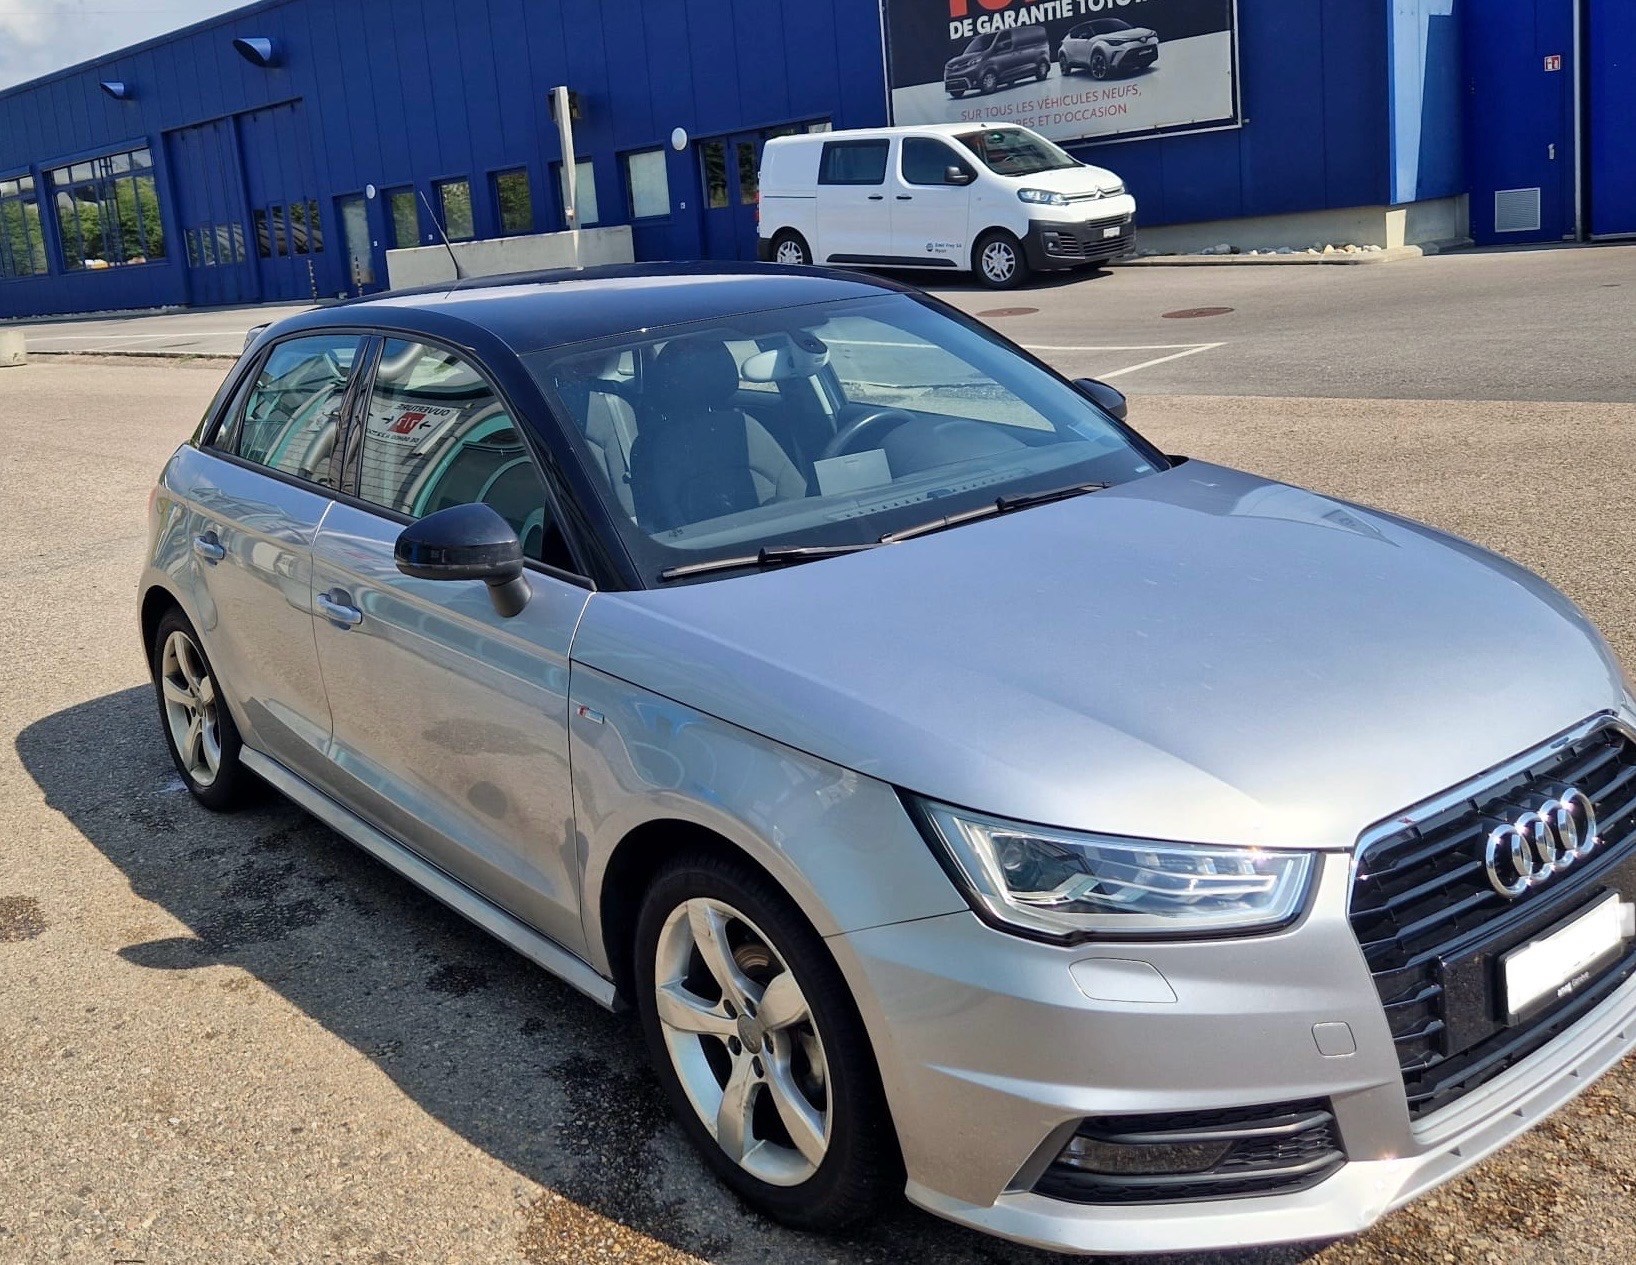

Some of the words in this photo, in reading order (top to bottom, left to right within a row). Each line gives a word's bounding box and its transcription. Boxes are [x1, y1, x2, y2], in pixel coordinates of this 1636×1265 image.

[949, 18, 974, 40] DE
[976, 0, 1073, 34] GARANTIE
[960, 108, 983, 122] SUR
[985, 103, 1013, 118] TOUS
[1016, 100, 1035, 114] LES
[1037, 90, 1099, 110] VÉHICULES
[1102, 83, 1142, 101] NEUFS,
[1038, 115, 1050, 127] ET
[1053, 103, 1127, 125] D'OCCASION
